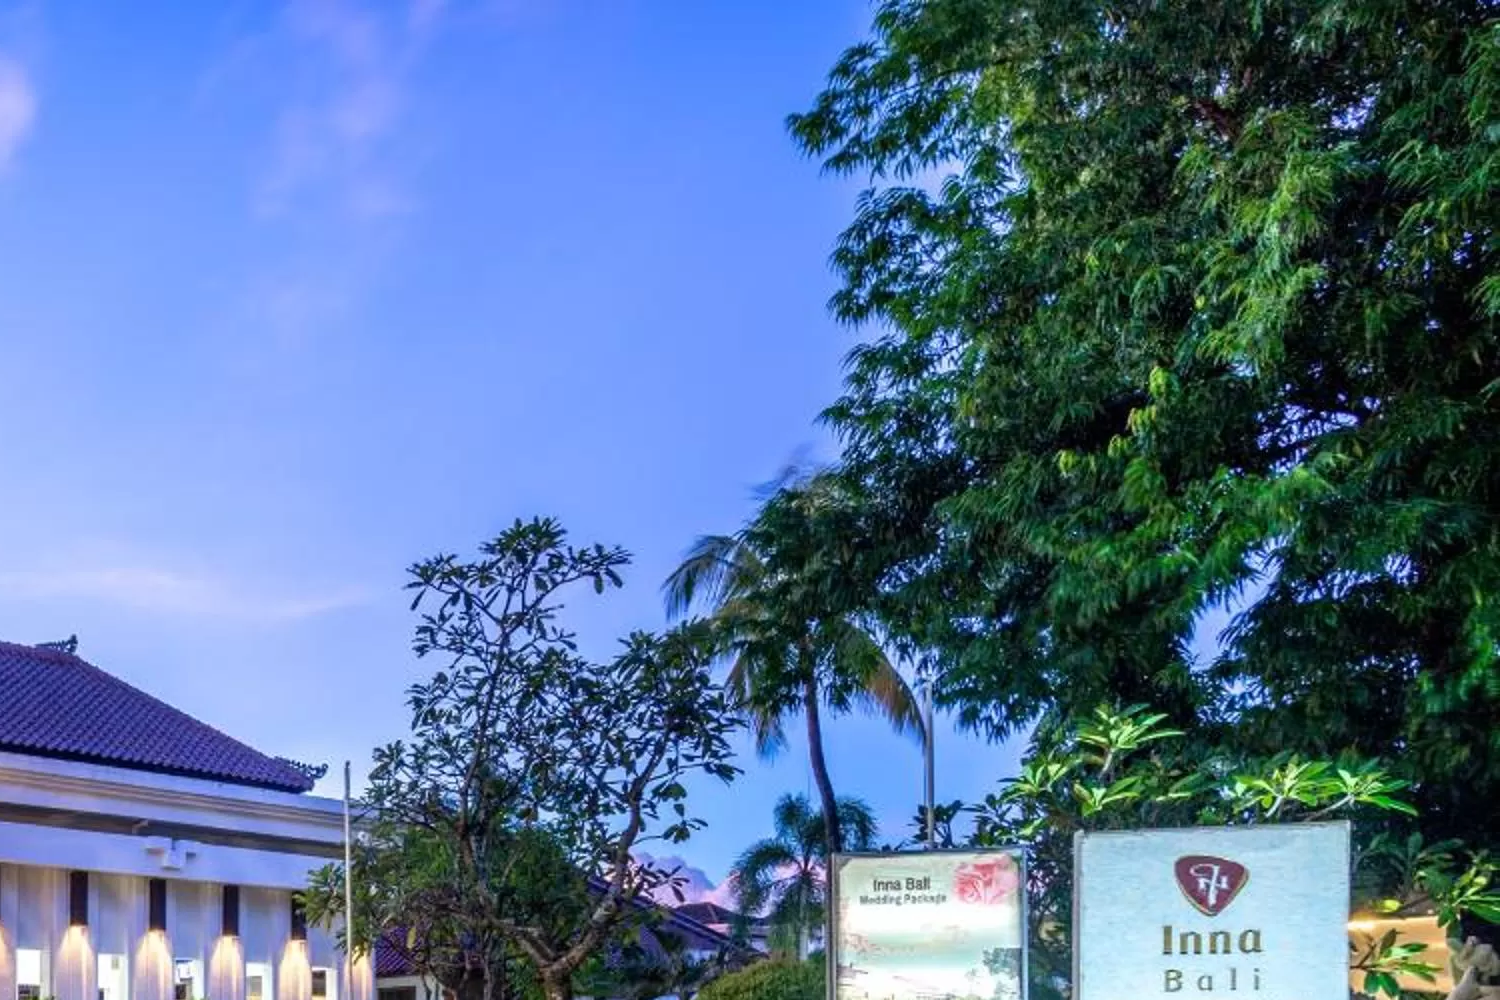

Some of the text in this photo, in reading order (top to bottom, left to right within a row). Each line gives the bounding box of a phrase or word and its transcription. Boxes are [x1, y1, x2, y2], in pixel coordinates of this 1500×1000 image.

[873, 877, 931, 892] Inna Bali
[904, 893, 947, 905] Package
[1162, 925, 1264, 955] Inna
[1164, 967, 1260, 992] Bali
